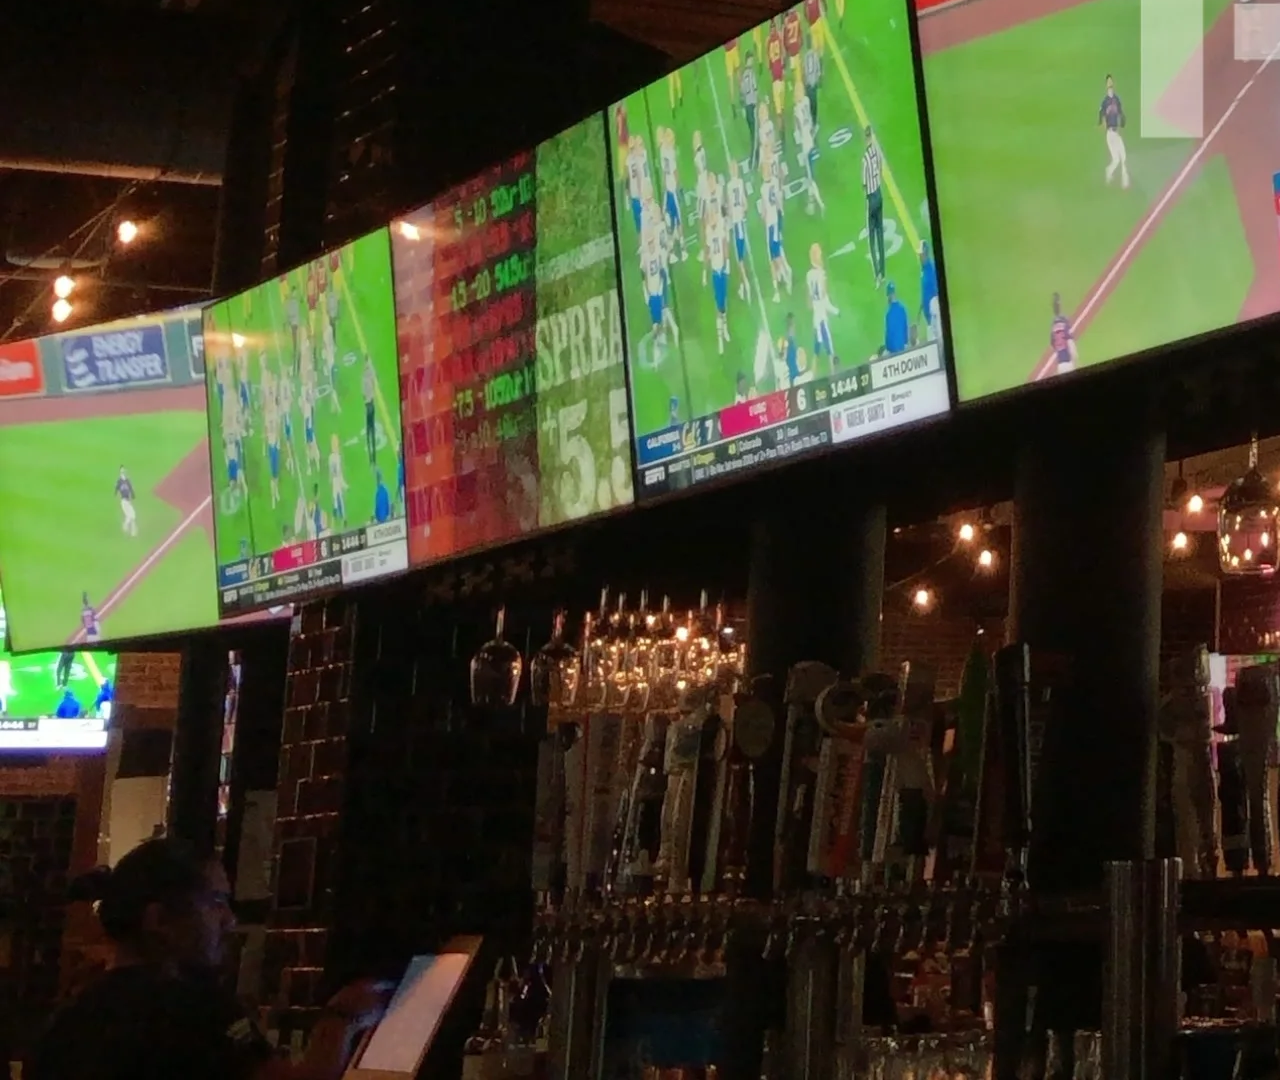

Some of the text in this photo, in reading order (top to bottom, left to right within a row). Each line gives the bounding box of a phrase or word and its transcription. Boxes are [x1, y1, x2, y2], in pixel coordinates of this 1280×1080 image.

[91, 330, 144, 358] ENERGY
[797, 388, 807, 411] 6
[831, 375, 858, 398] 14:44
[882, 363, 900, 379] 4TH
[901, 353, 928, 374] DOWN
